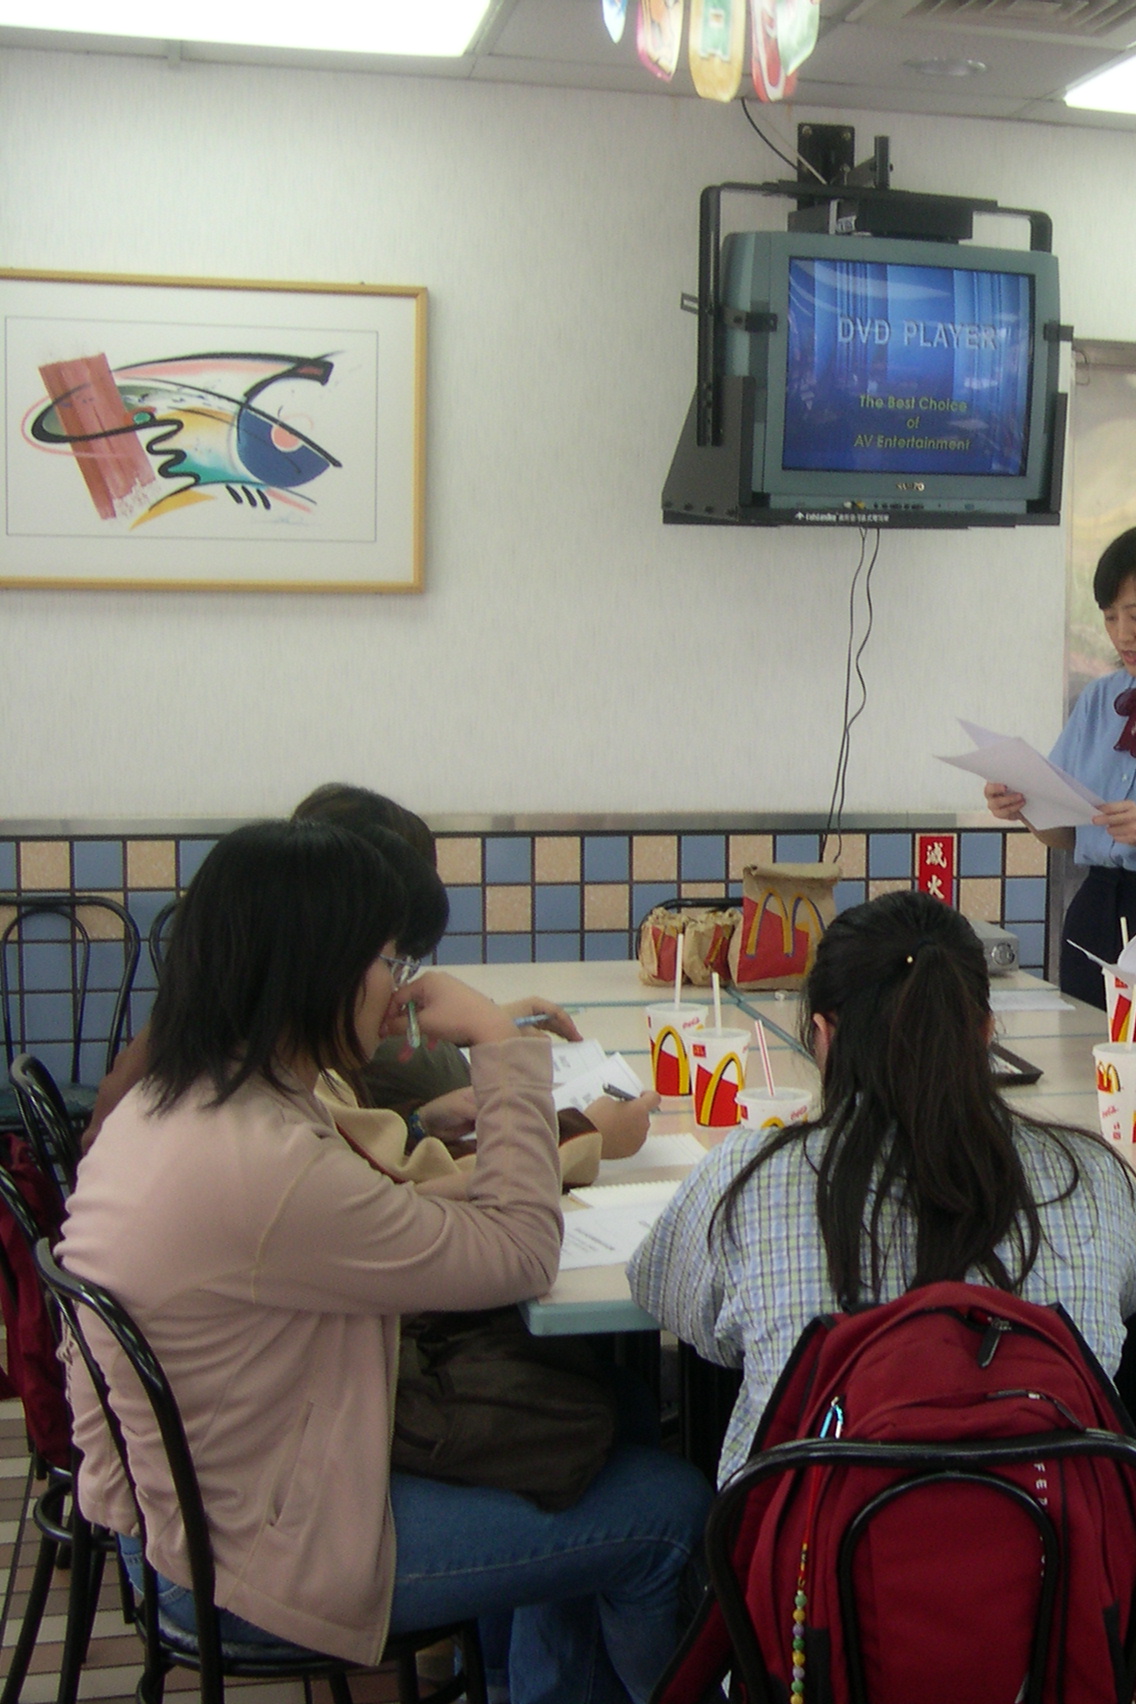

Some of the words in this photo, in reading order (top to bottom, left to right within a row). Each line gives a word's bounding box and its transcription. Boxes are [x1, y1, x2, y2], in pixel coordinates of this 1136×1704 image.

[838, 315, 891, 345] DVD
[903, 321, 998, 350] PLAYER
[860, 395, 884, 409] The
[888, 397, 915, 410] Best
[918, 398, 967, 413] Choice
[906, 417, 920, 430] of
[854, 435, 873, 448] AV
[876, 436, 972, 450] Entertainment
